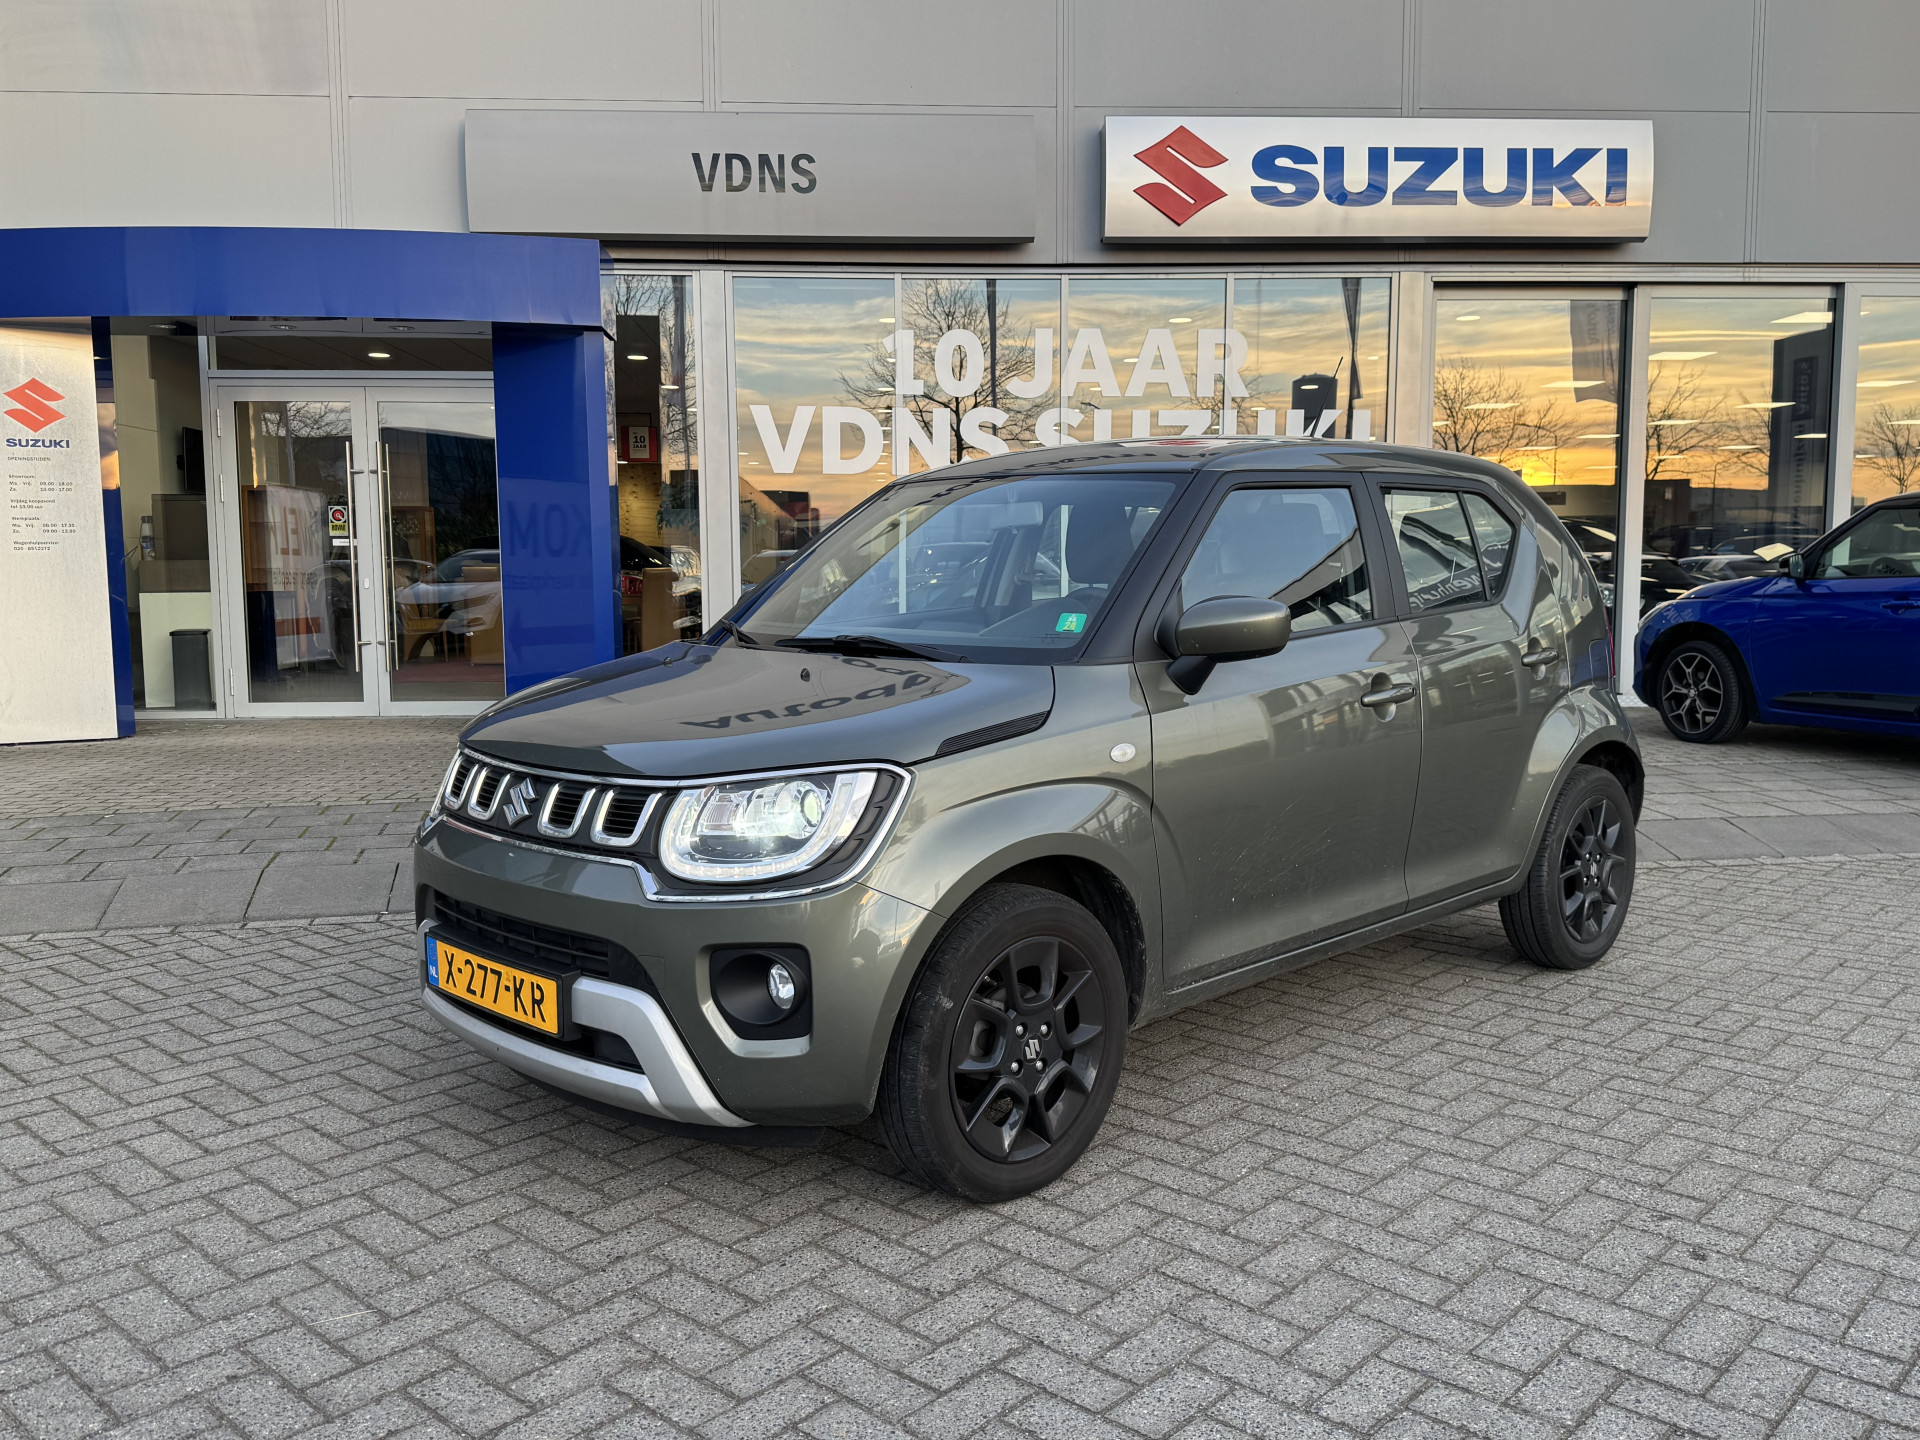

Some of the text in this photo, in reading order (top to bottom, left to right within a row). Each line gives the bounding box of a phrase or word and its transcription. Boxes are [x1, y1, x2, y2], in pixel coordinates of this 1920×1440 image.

[691, 152, 817, 194] VDNS
[1250, 144, 1628, 207] SUZUKI
[882, 328, 1250, 398] 10 JAAR
[5, 438, 70, 449] SUZUKI
[633, 435, 646, 444] 10
[749, 404, 1011, 475] VDNS
[429, 964, 438, 978] NL
[444, 949, 547, 1023] X-277-KR
